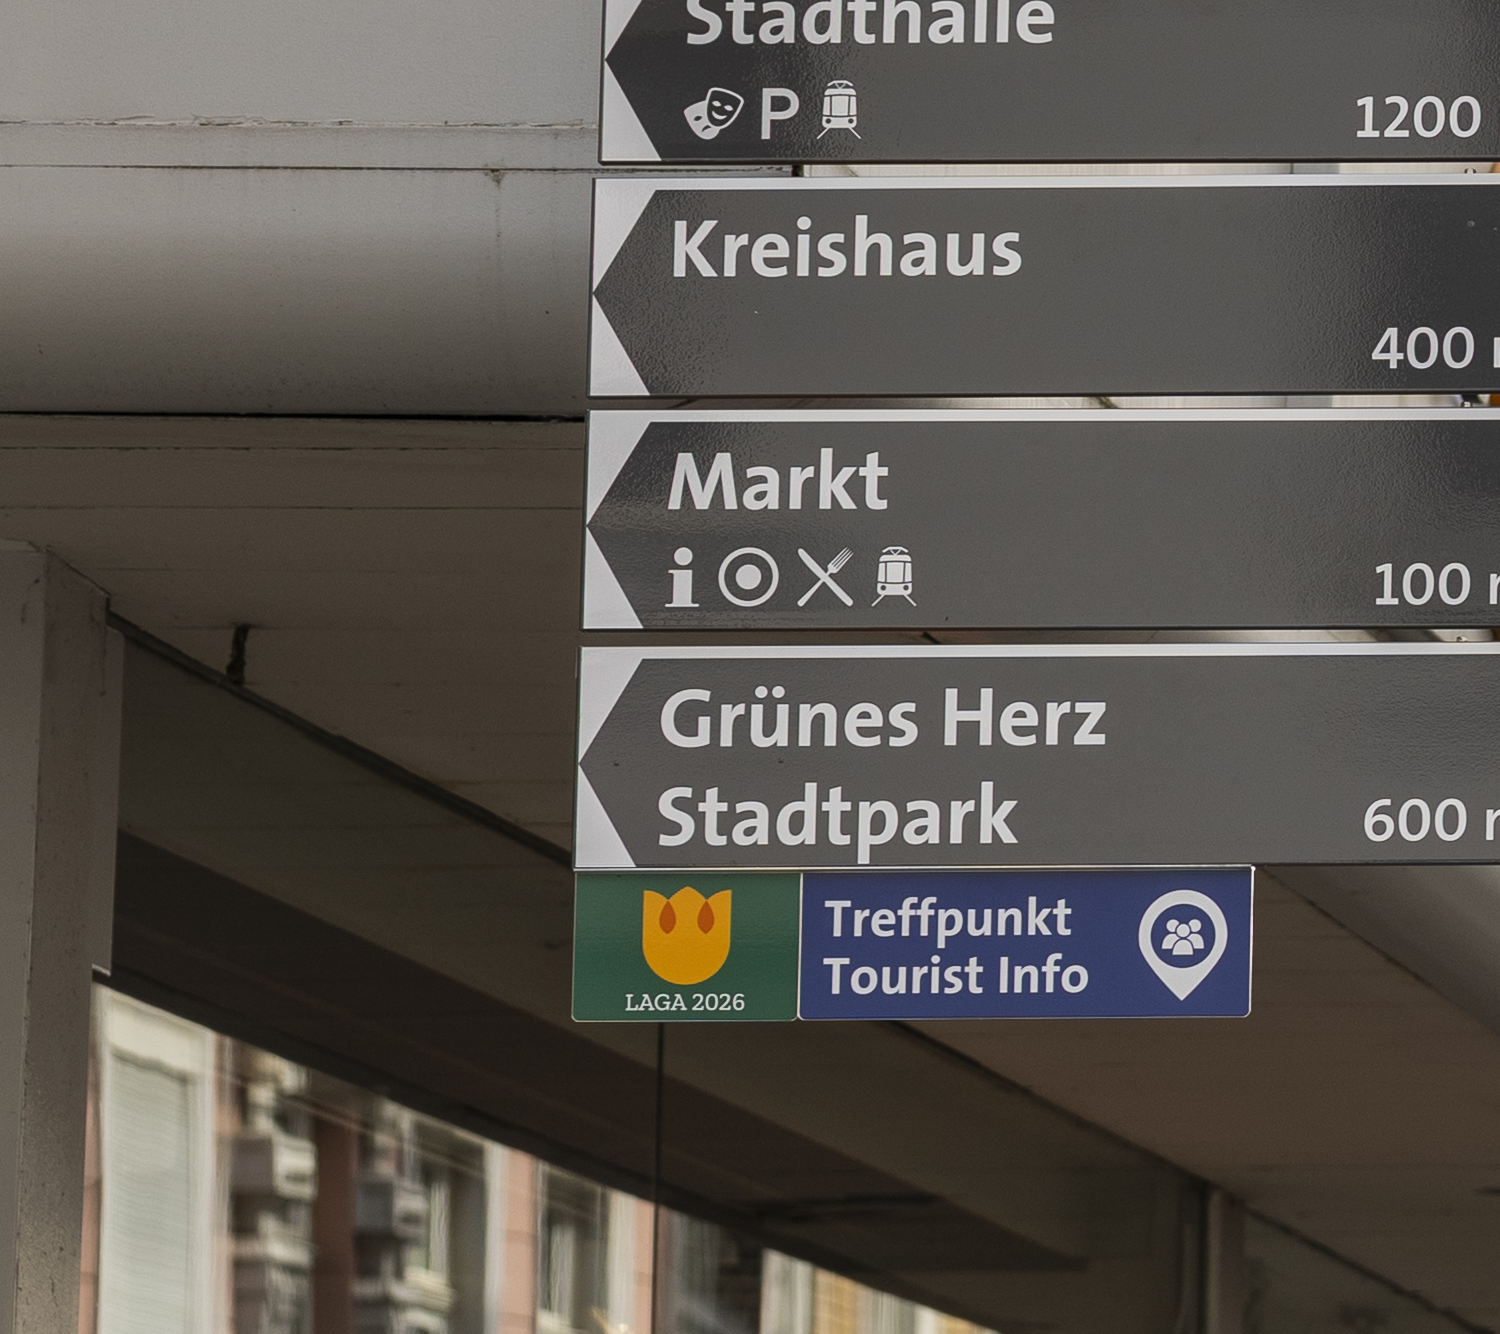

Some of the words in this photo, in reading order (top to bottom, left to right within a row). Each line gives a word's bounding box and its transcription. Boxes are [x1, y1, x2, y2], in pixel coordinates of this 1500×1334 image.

[1355, 95, 1483, 139] 1200
[672, 214, 1023, 279] Kreishaus
[1370, 326, 1476, 370] 400
[667, 447, 889, 511] Markt
[1374, 562, 1472, 606] 100
[659, 685, 919, 748] Grünes
[942, 687, 1108, 747] Herz
[657, 782, 1019, 863] Stadtpark
[1362, 797, 1469, 843] 600
[823, 896, 1073, 949] Treffpunkt
[822, 953, 985, 996] Tourist
[998, 952, 1090, 995] Info
[624, 993, 684, 1012] LAGA
[690, 992, 746, 1012] 2026
